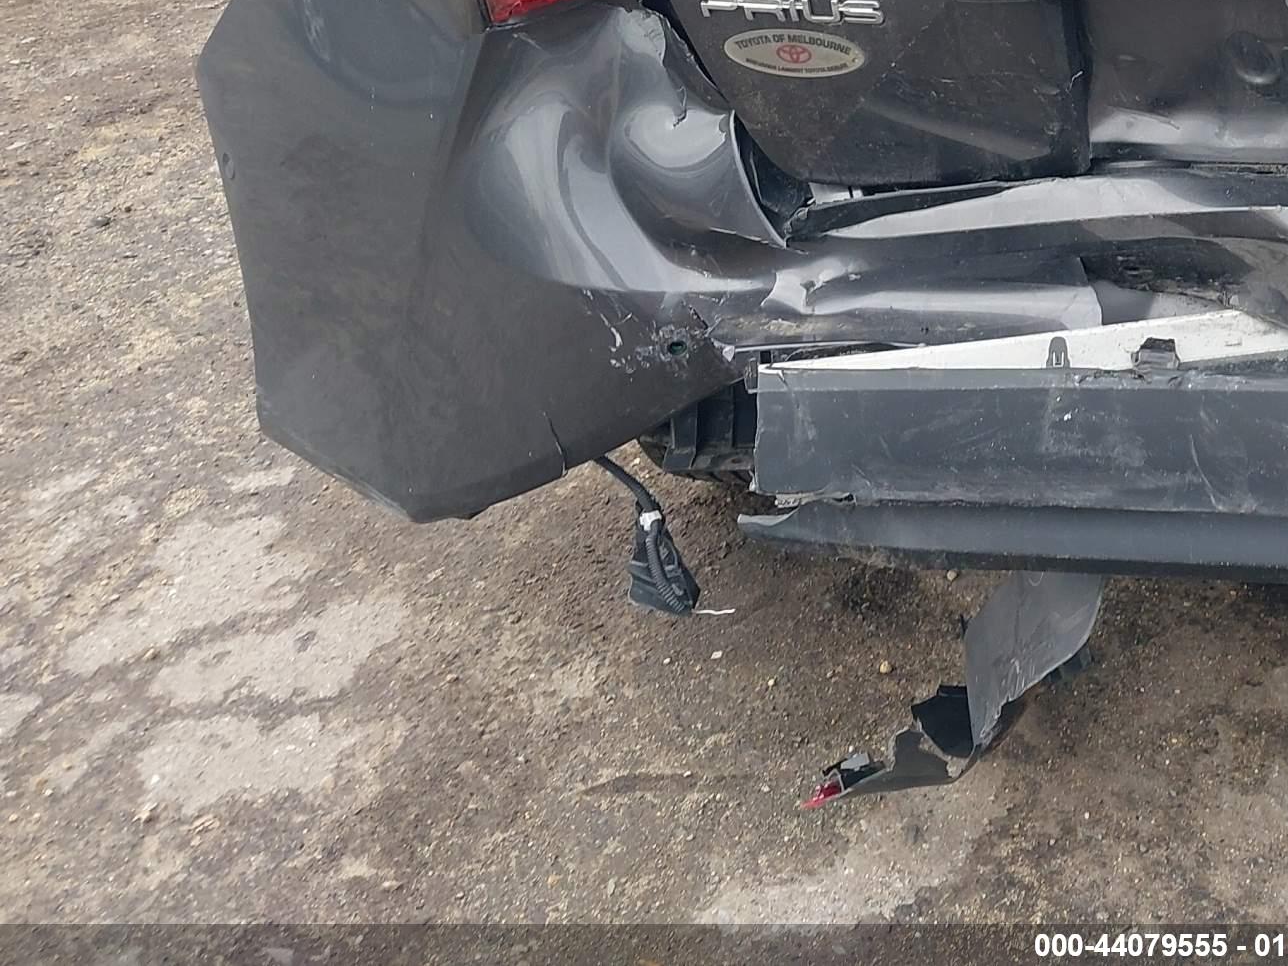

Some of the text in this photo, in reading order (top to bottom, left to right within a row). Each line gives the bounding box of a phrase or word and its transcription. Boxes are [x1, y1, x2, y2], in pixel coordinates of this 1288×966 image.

[734, 33, 852, 56] TOYOTA OF MELBOURNE
